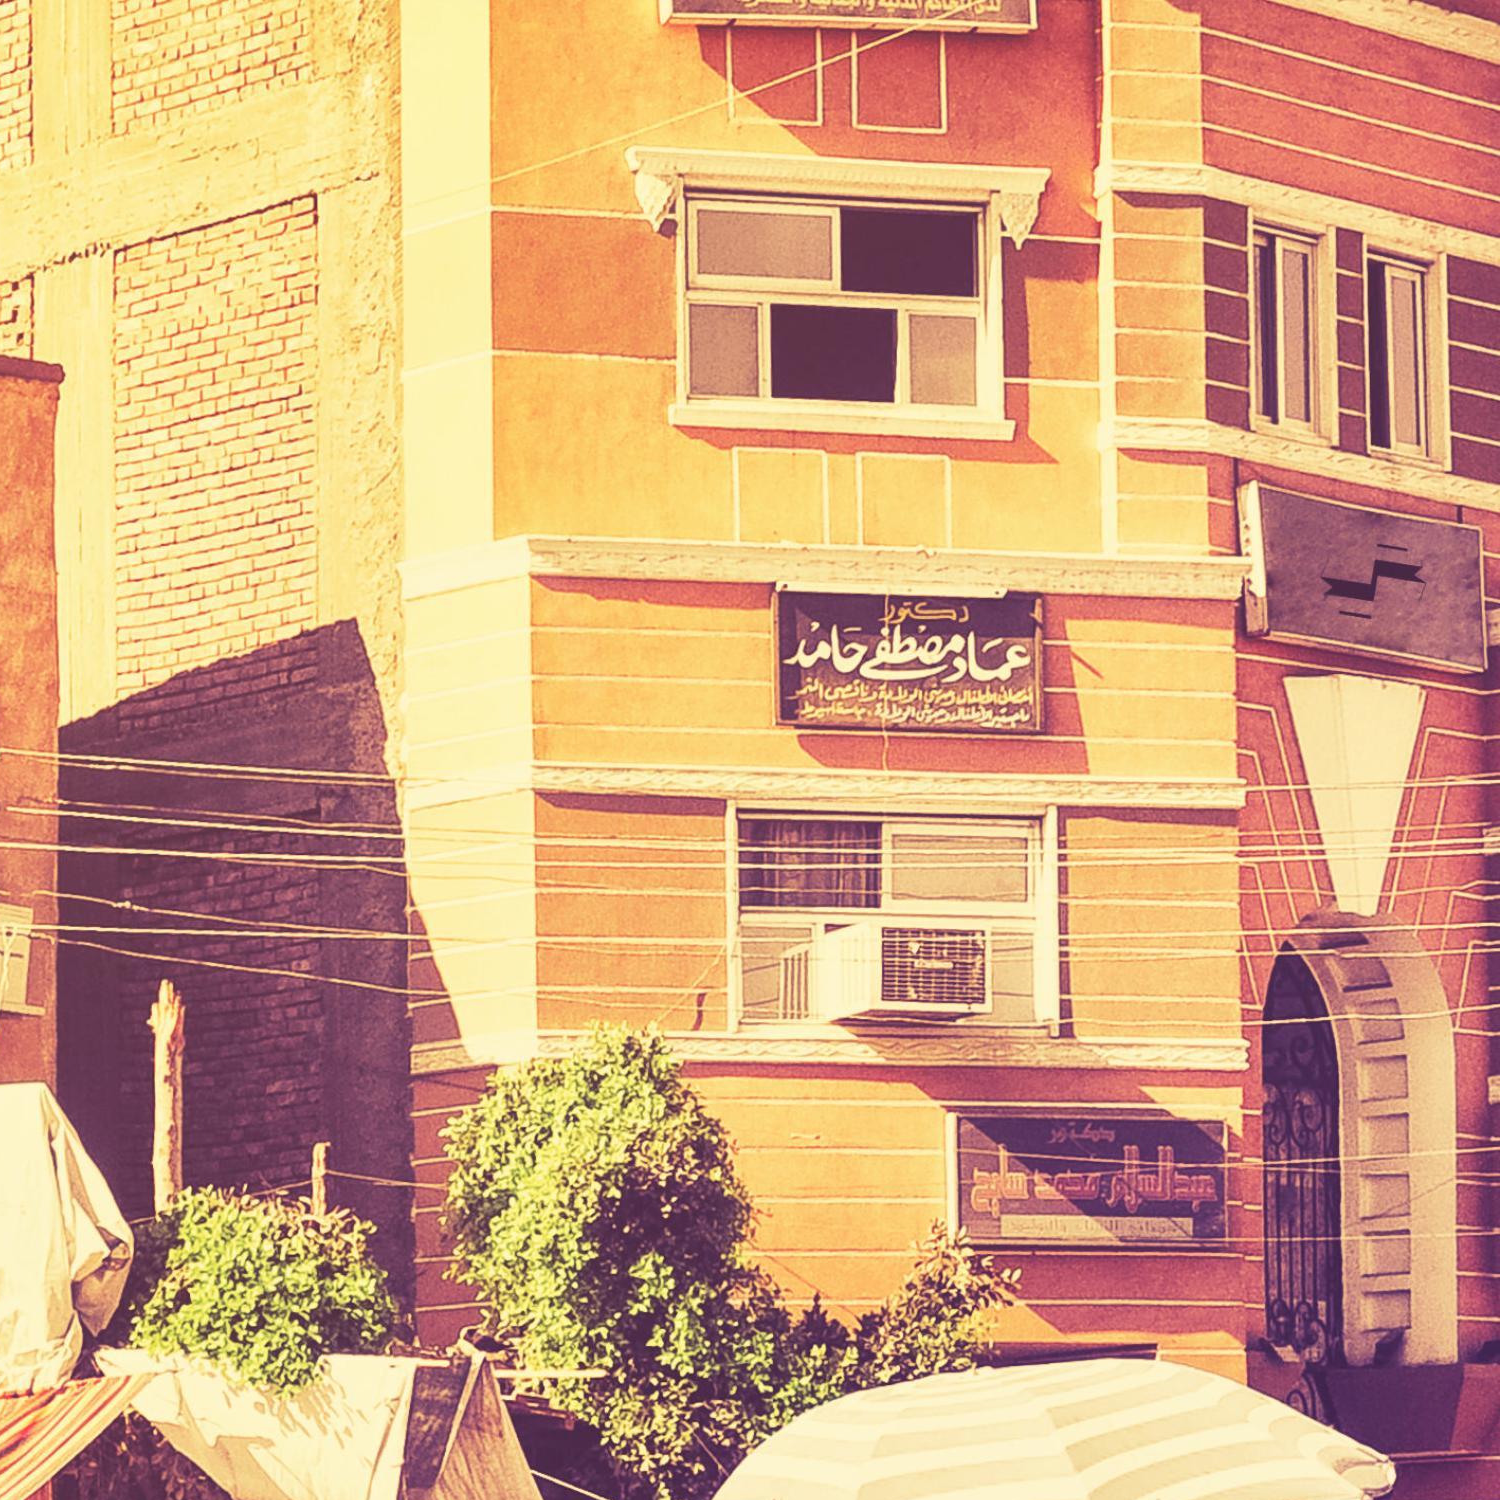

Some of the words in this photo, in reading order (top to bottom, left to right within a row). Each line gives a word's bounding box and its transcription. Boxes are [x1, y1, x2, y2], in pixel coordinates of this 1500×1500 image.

[878, 601, 970, 625] دكتور
[782, 621, 870, 674] حامد
[859, 622, 967, 681] مصطفى
[942, 630, 1032, 684] عماد
